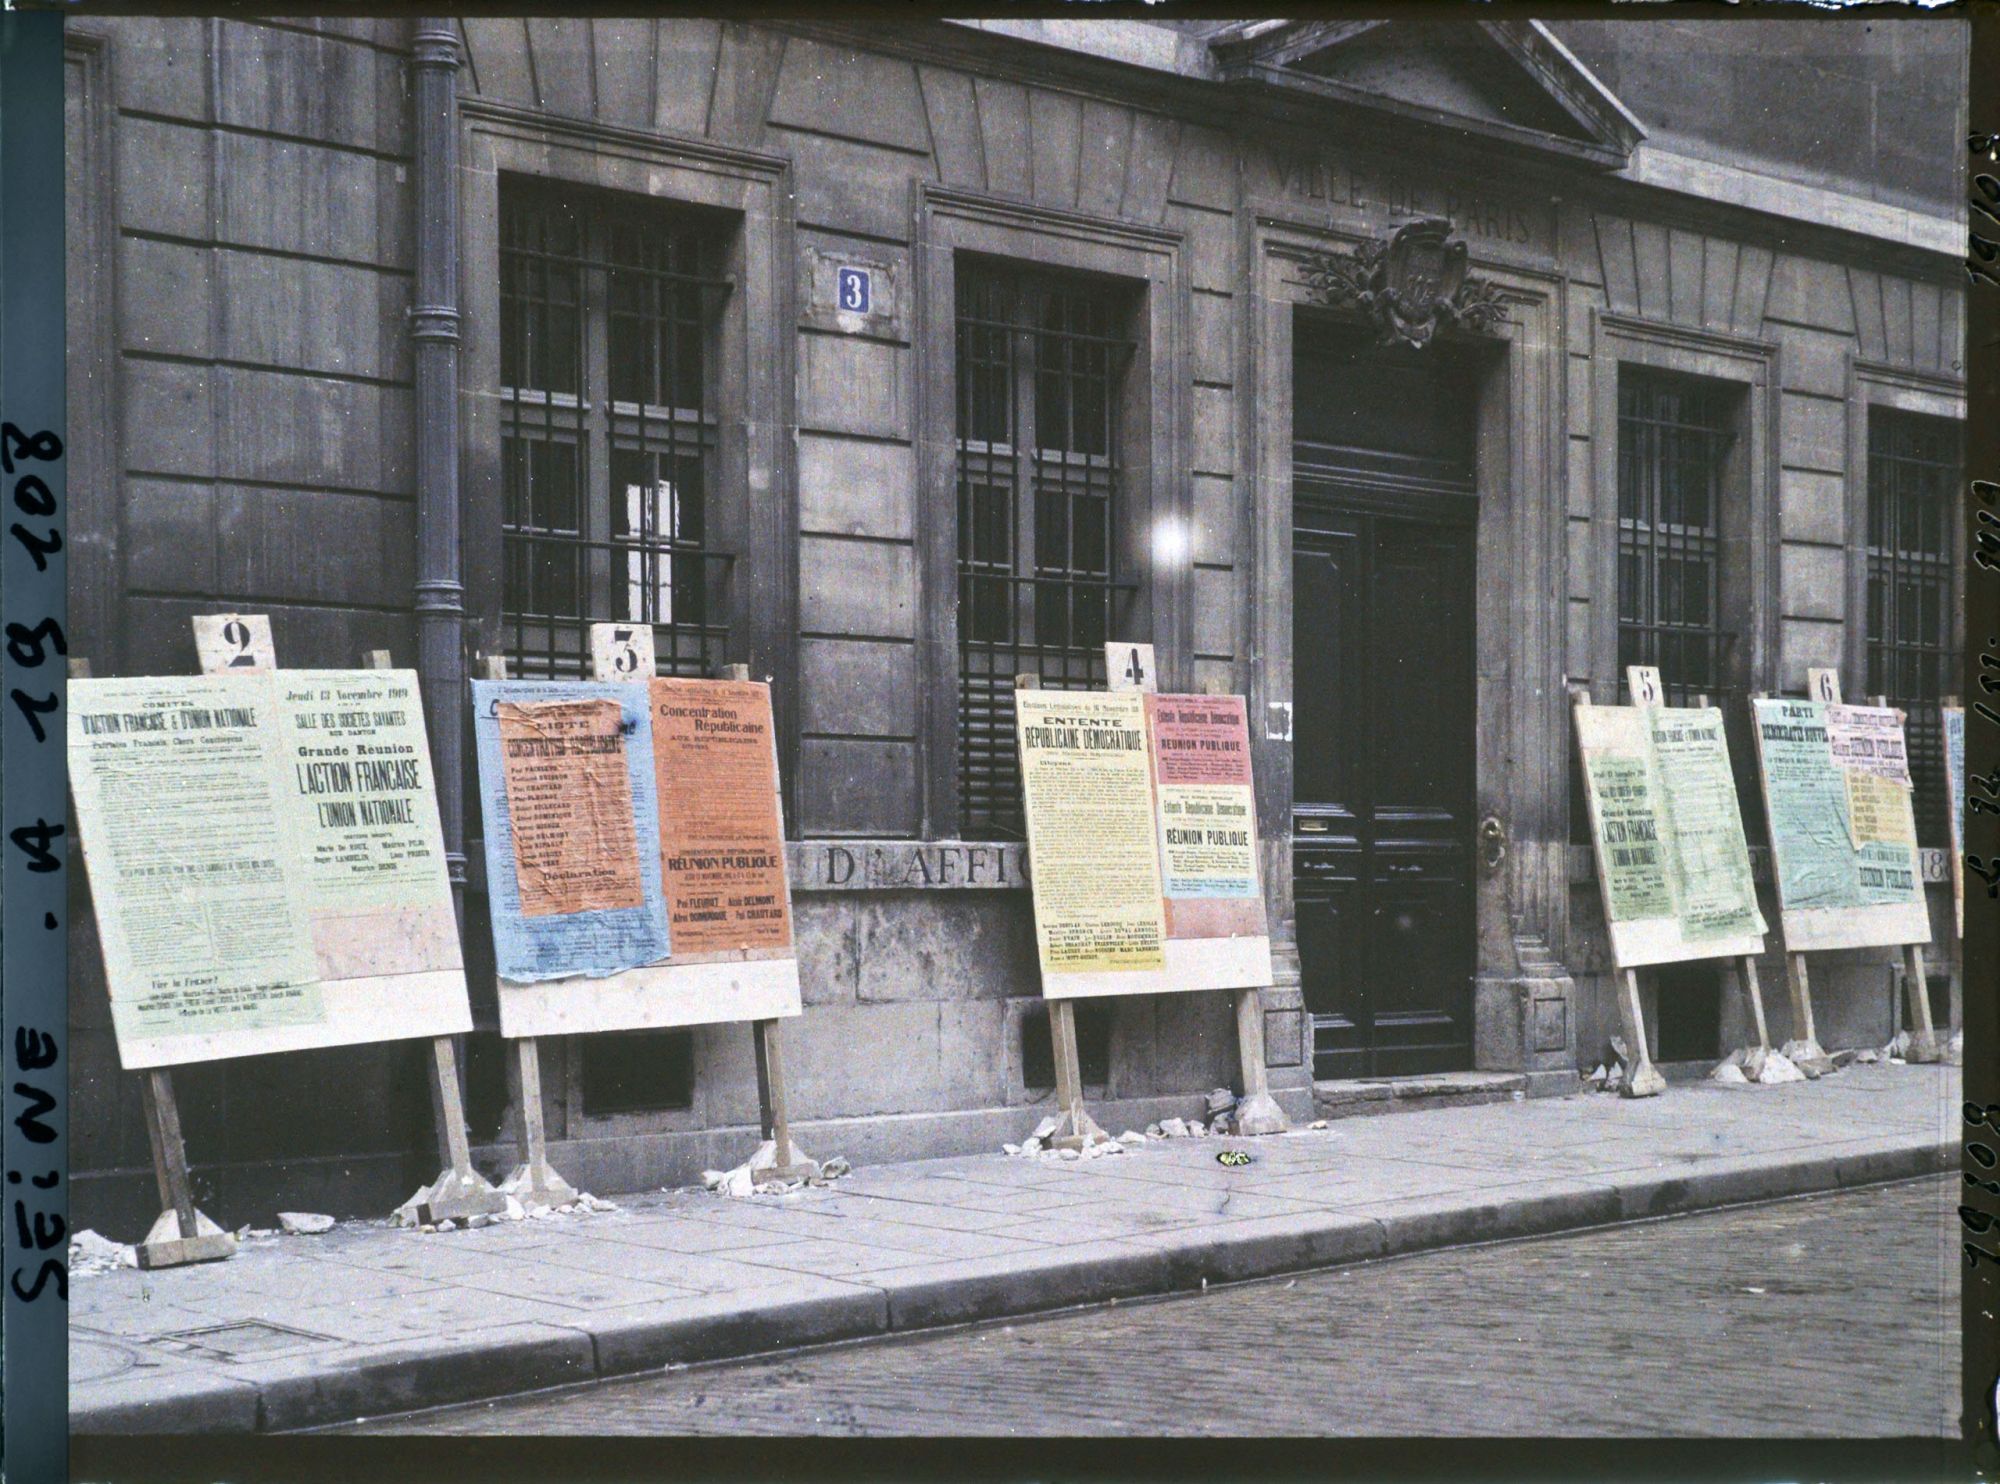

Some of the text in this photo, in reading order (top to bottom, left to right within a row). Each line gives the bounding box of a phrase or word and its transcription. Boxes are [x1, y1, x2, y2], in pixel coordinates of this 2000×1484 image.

[846, 274, 862, 308] 3
[2, 422, 63, 572] 108
[224, 621, 256, 667] 2
[614, 631, 638, 673] 3
[1125, 648, 1145, 686] 4
[286, 690, 313, 701] Jeudi
[337, 688, 383, 701] Novembre
[388, 687, 408, 699] 1919
[1640, 671, 1654, 702] 5
[1820, 673, 1832, 701] 6
[213, 707, 257, 728] NATIONALE
[295, 713, 317, 729] SALLE
[320, 712, 336, 729] DES
[373, 710, 407, 726] SAVANTES
[660, 703, 737, 720] Concentration
[1043, 716, 1122, 727] ENTENTE
[1782, 706, 1813, 718] PARTI
[1025, 724, 1142, 751] RÉPUBLICAINE DÉMOCRATIQUE
[1200, 739, 1241, 752] PUBLIQUE
[298, 745, 349, 757] Grande
[317, 798, 414, 828] L'UNION NATIONALE
[1166, 826, 1249, 847] RÉUNION PUBLIQUE
[668, 855, 777, 871] RÉUNION PUBLIQUE
